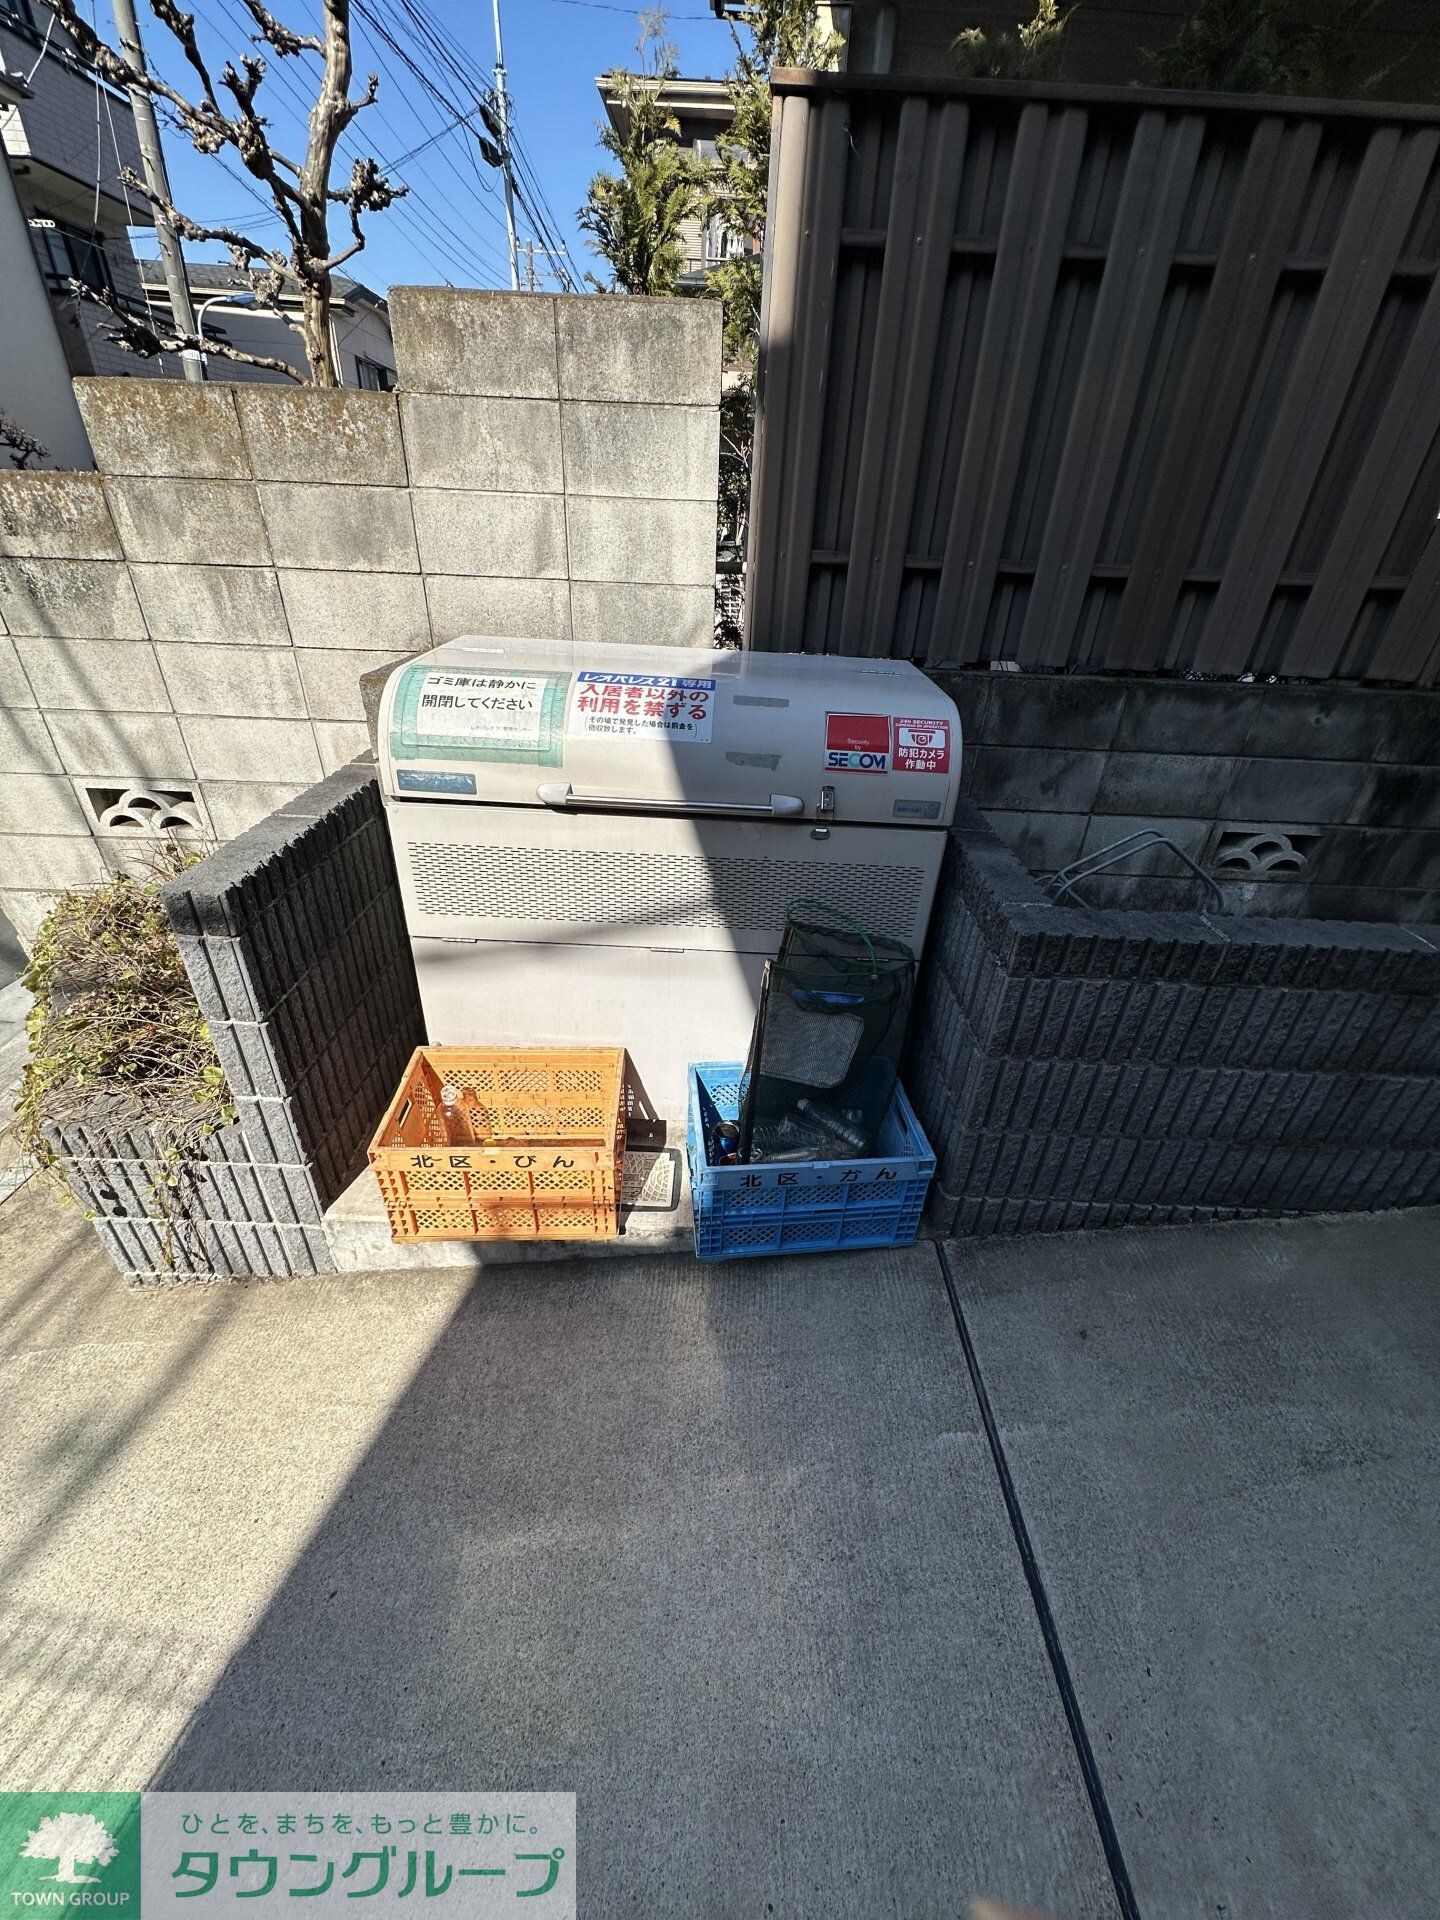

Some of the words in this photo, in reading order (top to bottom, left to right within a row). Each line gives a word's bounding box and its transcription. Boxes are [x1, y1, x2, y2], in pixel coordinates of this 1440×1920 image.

[428, 676, 537, 690] ゴミ庫は静かに
[580, 683, 709, 702] 入居者以外の
[422, 694, 533, 711] 開閉してください
[578, 696, 707, 720] 利用を禁ずる
[847, 737, 870, 746] Security
[828, 751, 886, 769] SECOM
[898, 747, 945, 760] 防犯カメラ
[904, 759, 936, 770] 作動中
